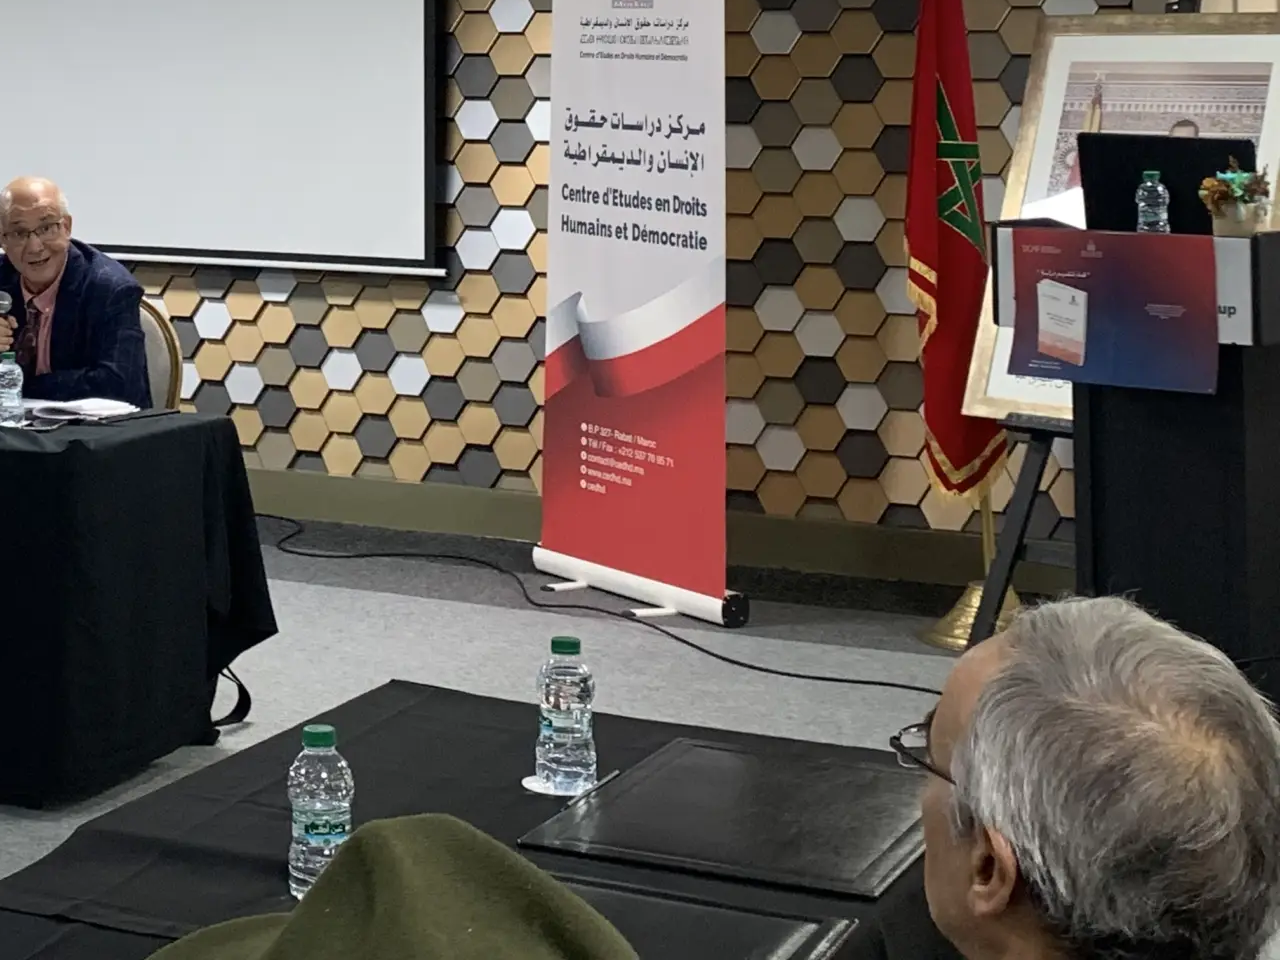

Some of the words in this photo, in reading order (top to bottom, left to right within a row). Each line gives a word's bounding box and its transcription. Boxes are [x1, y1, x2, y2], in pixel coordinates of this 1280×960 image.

[564, 107, 607, 132] حقوق
[610, 112, 662, 137] دراسات
[664, 113, 705, 140] مركز
[563, 139, 654, 173] والديمقراطية
[657, 149, 704, 178] الإنسان
[561, 182, 600, 205] Centre
[602, 187, 653, 211] d'Etudes
[655, 197, 670, 213] en
[672, 195, 708, 217] Droits
[561, 214, 613, 238] Humains
[615, 222, 629, 241] et
[631, 222, 708, 251] Démocratie
